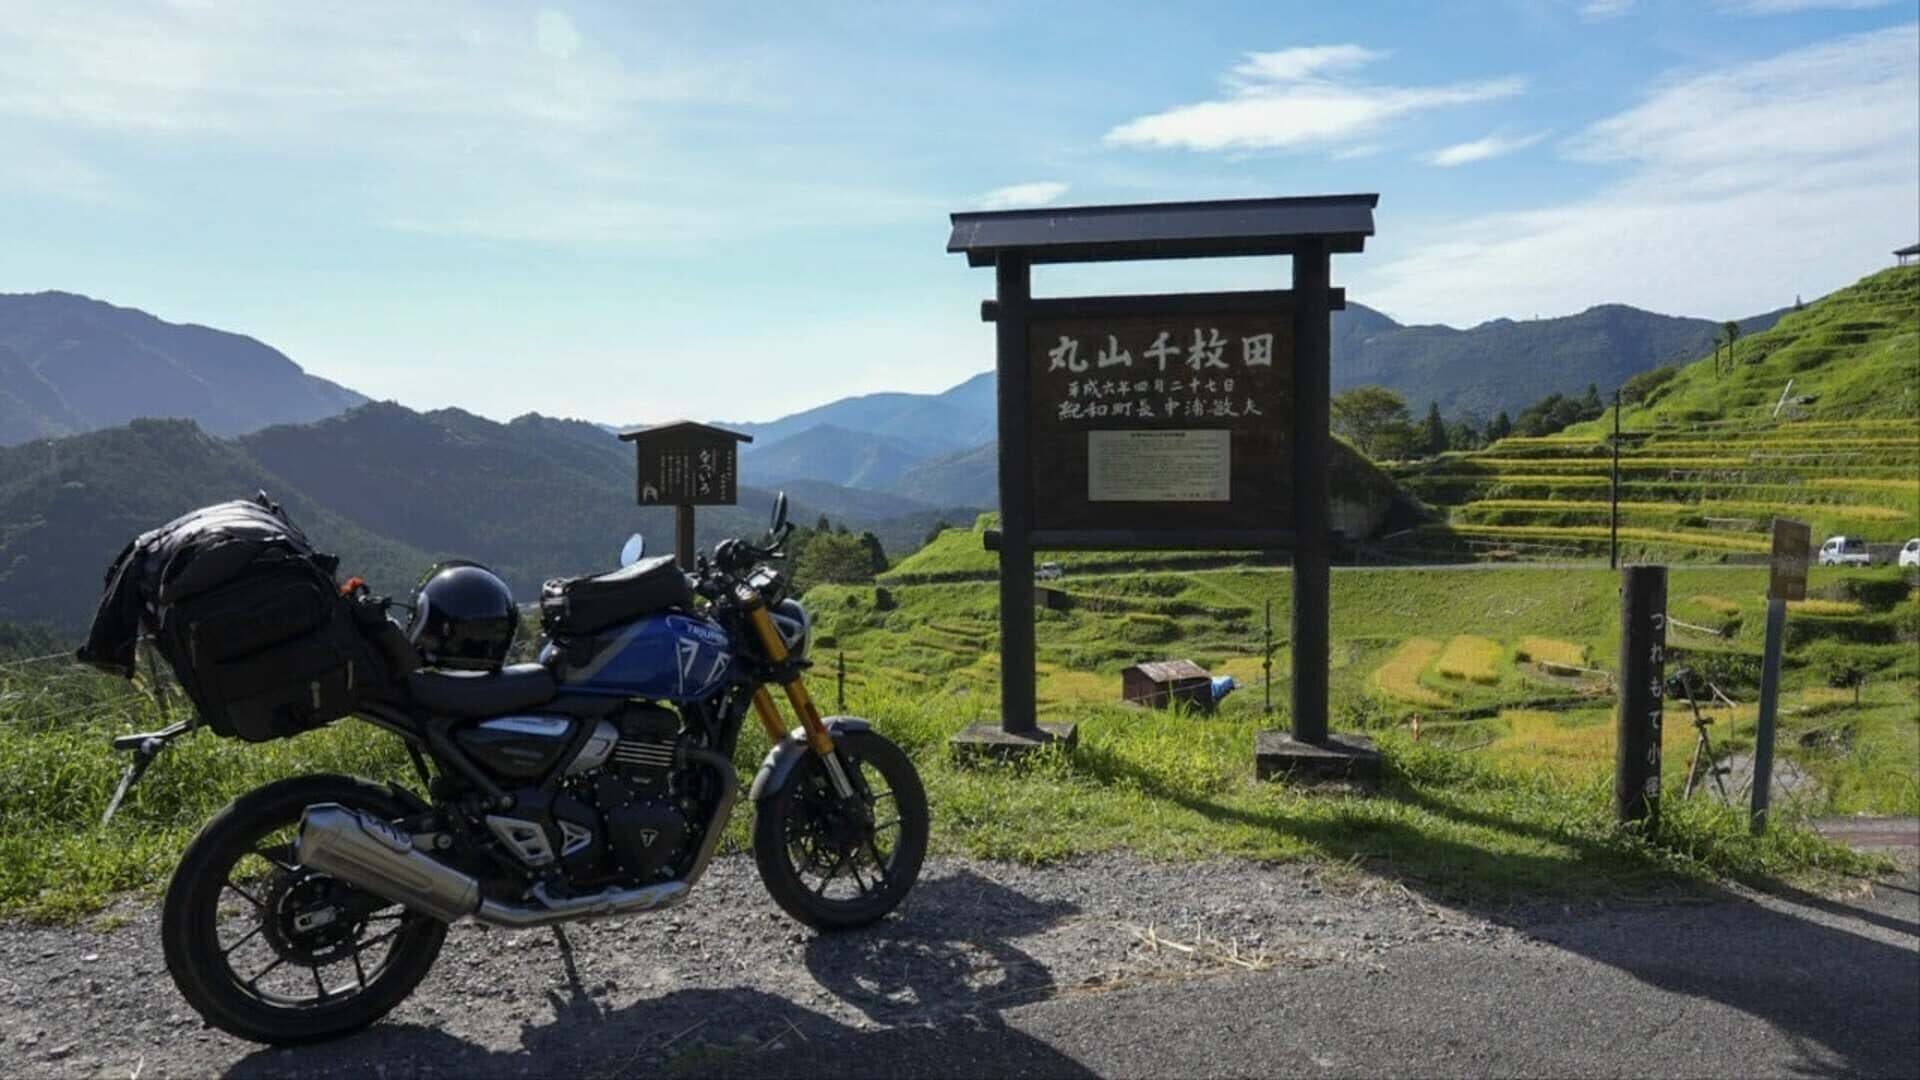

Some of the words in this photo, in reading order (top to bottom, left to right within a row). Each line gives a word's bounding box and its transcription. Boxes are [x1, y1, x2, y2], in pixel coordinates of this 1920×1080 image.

[1047, 327, 1274, 373] 丸山千枚田
[1068, 378, 1235, 397] 平成六年四月二十七日
